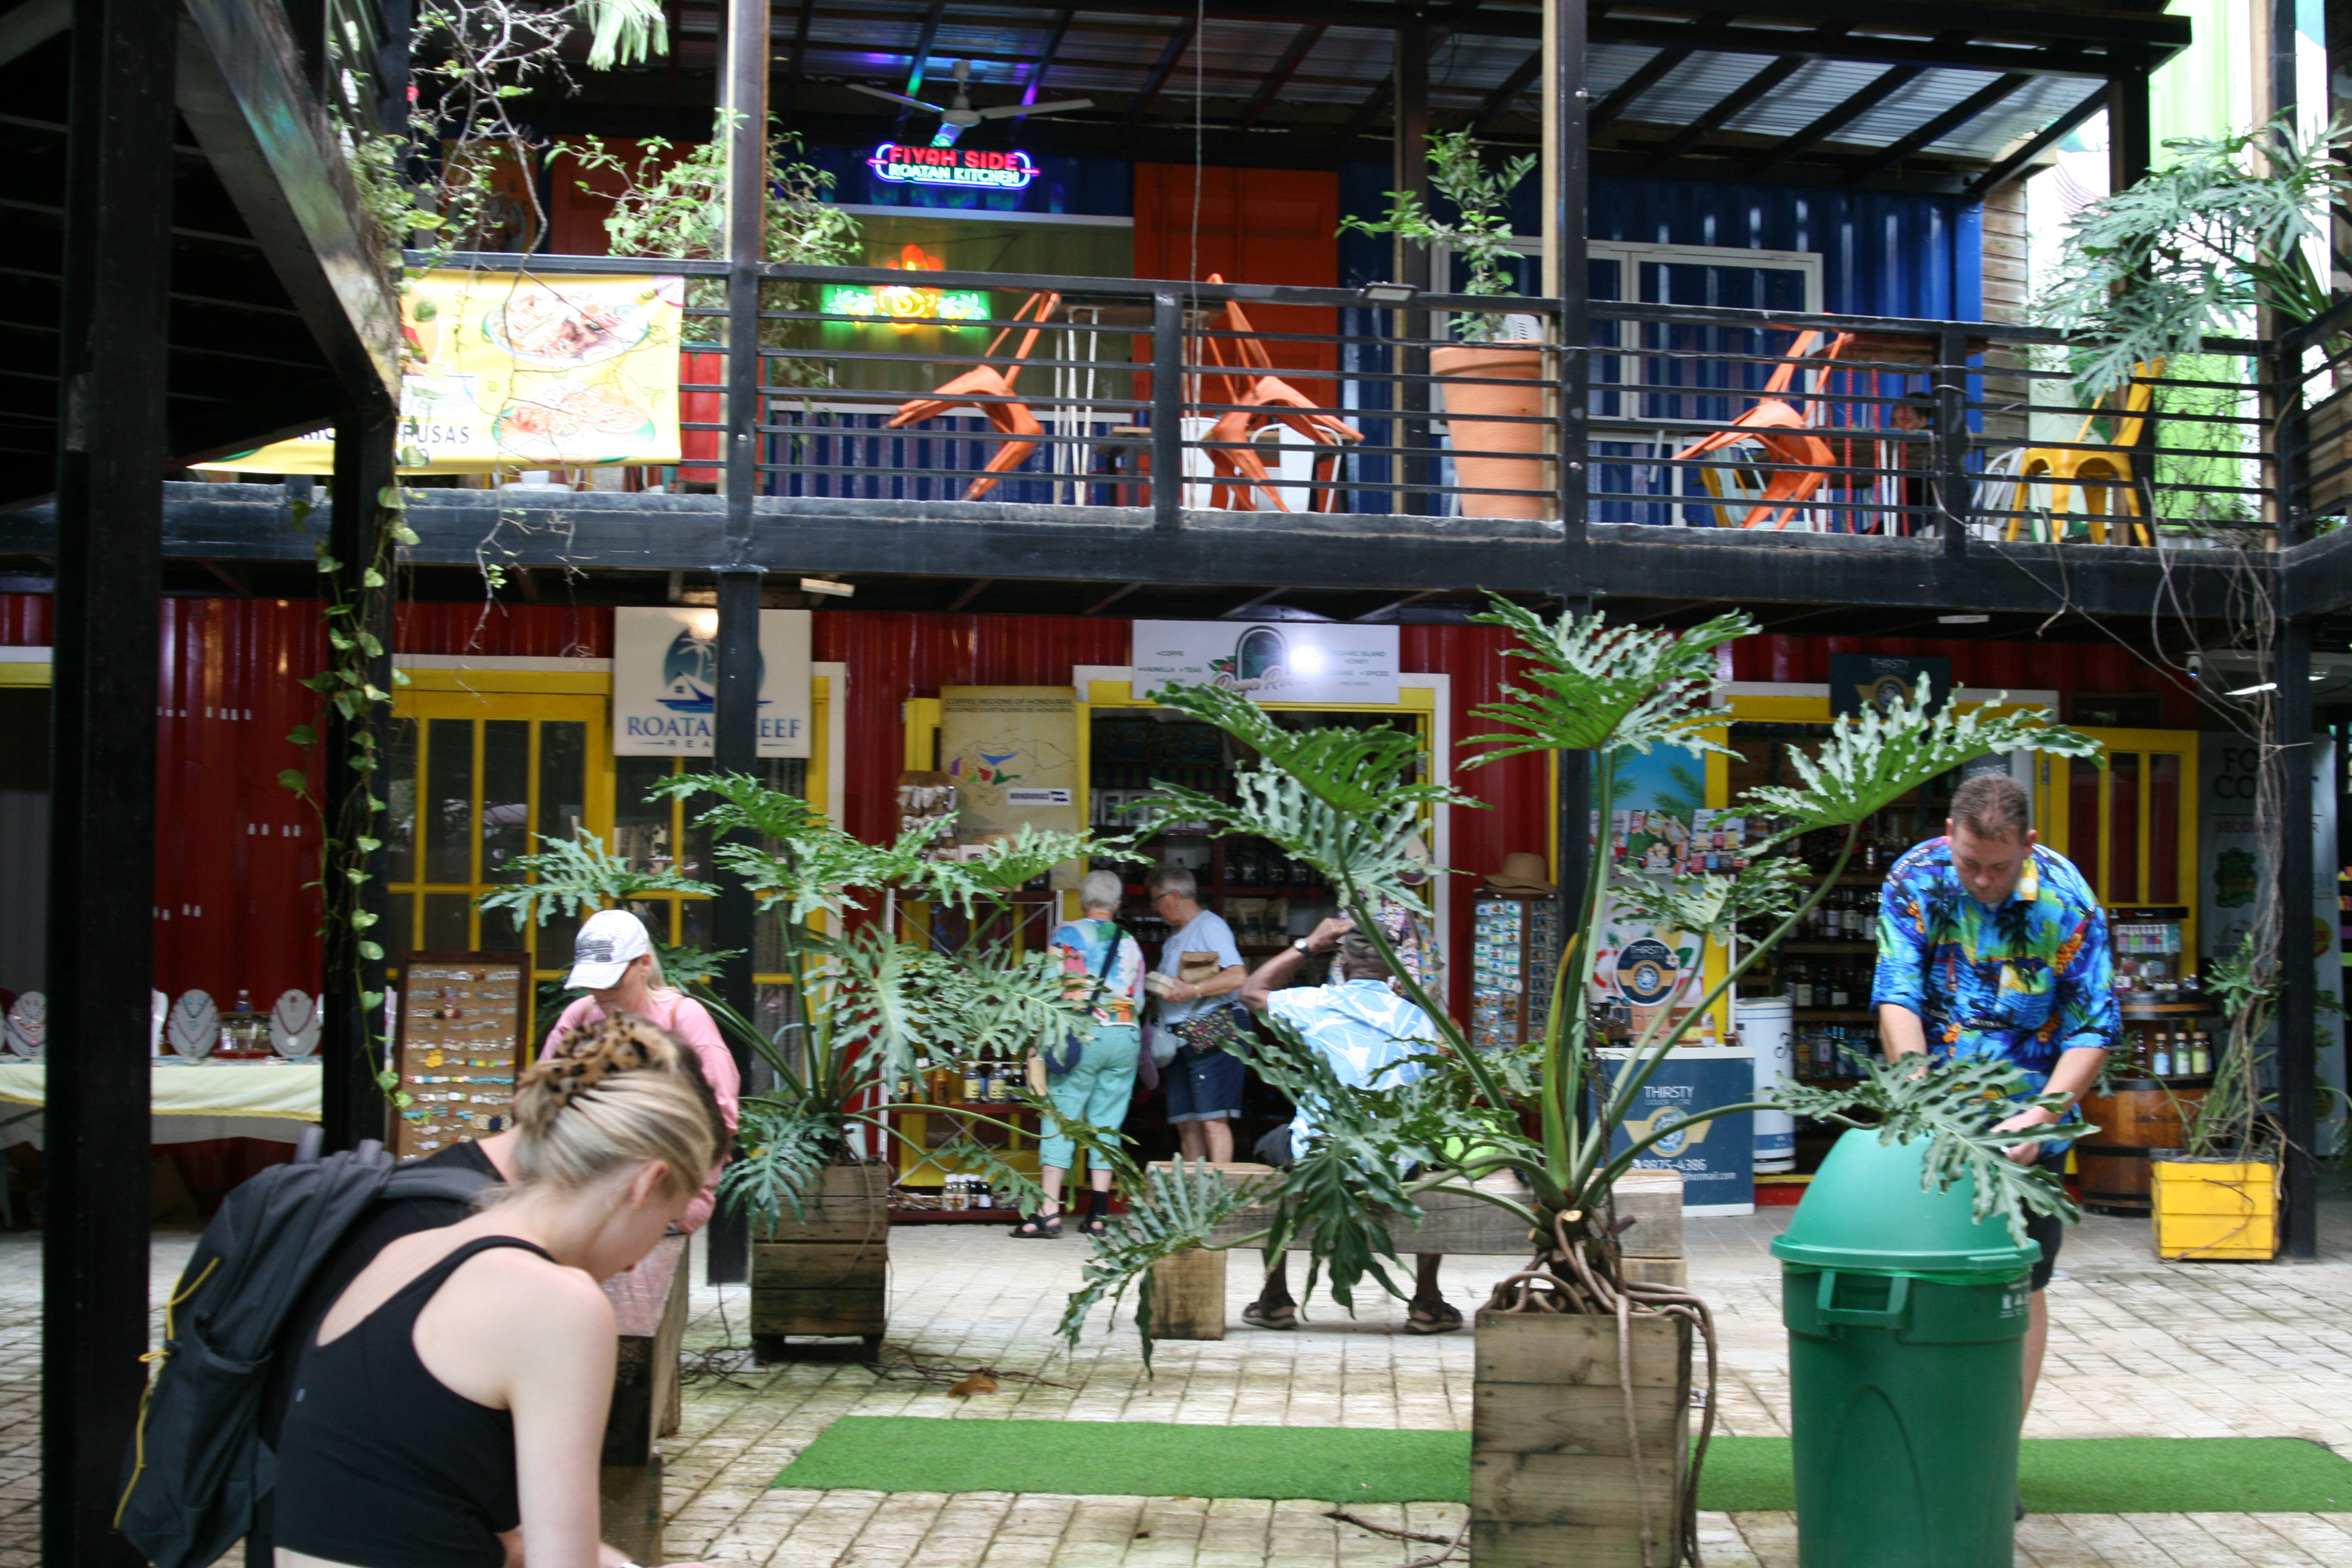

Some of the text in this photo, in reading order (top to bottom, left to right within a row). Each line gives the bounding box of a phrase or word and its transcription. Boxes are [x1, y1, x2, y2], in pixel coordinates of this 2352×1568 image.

[889, 146, 1018, 171] FIYAH SIDE
[888, 163, 1019, 183] ROATAN KITCHEN
[1870, 658, 1910, 669] THIRSTY
[627, 716, 802, 738] ROATA EEF
[667, 739, 712, 748] REA
[1630, 945, 1665, 955] THIRSTY
[1643, 1086, 1695, 1098] THIRSTY
